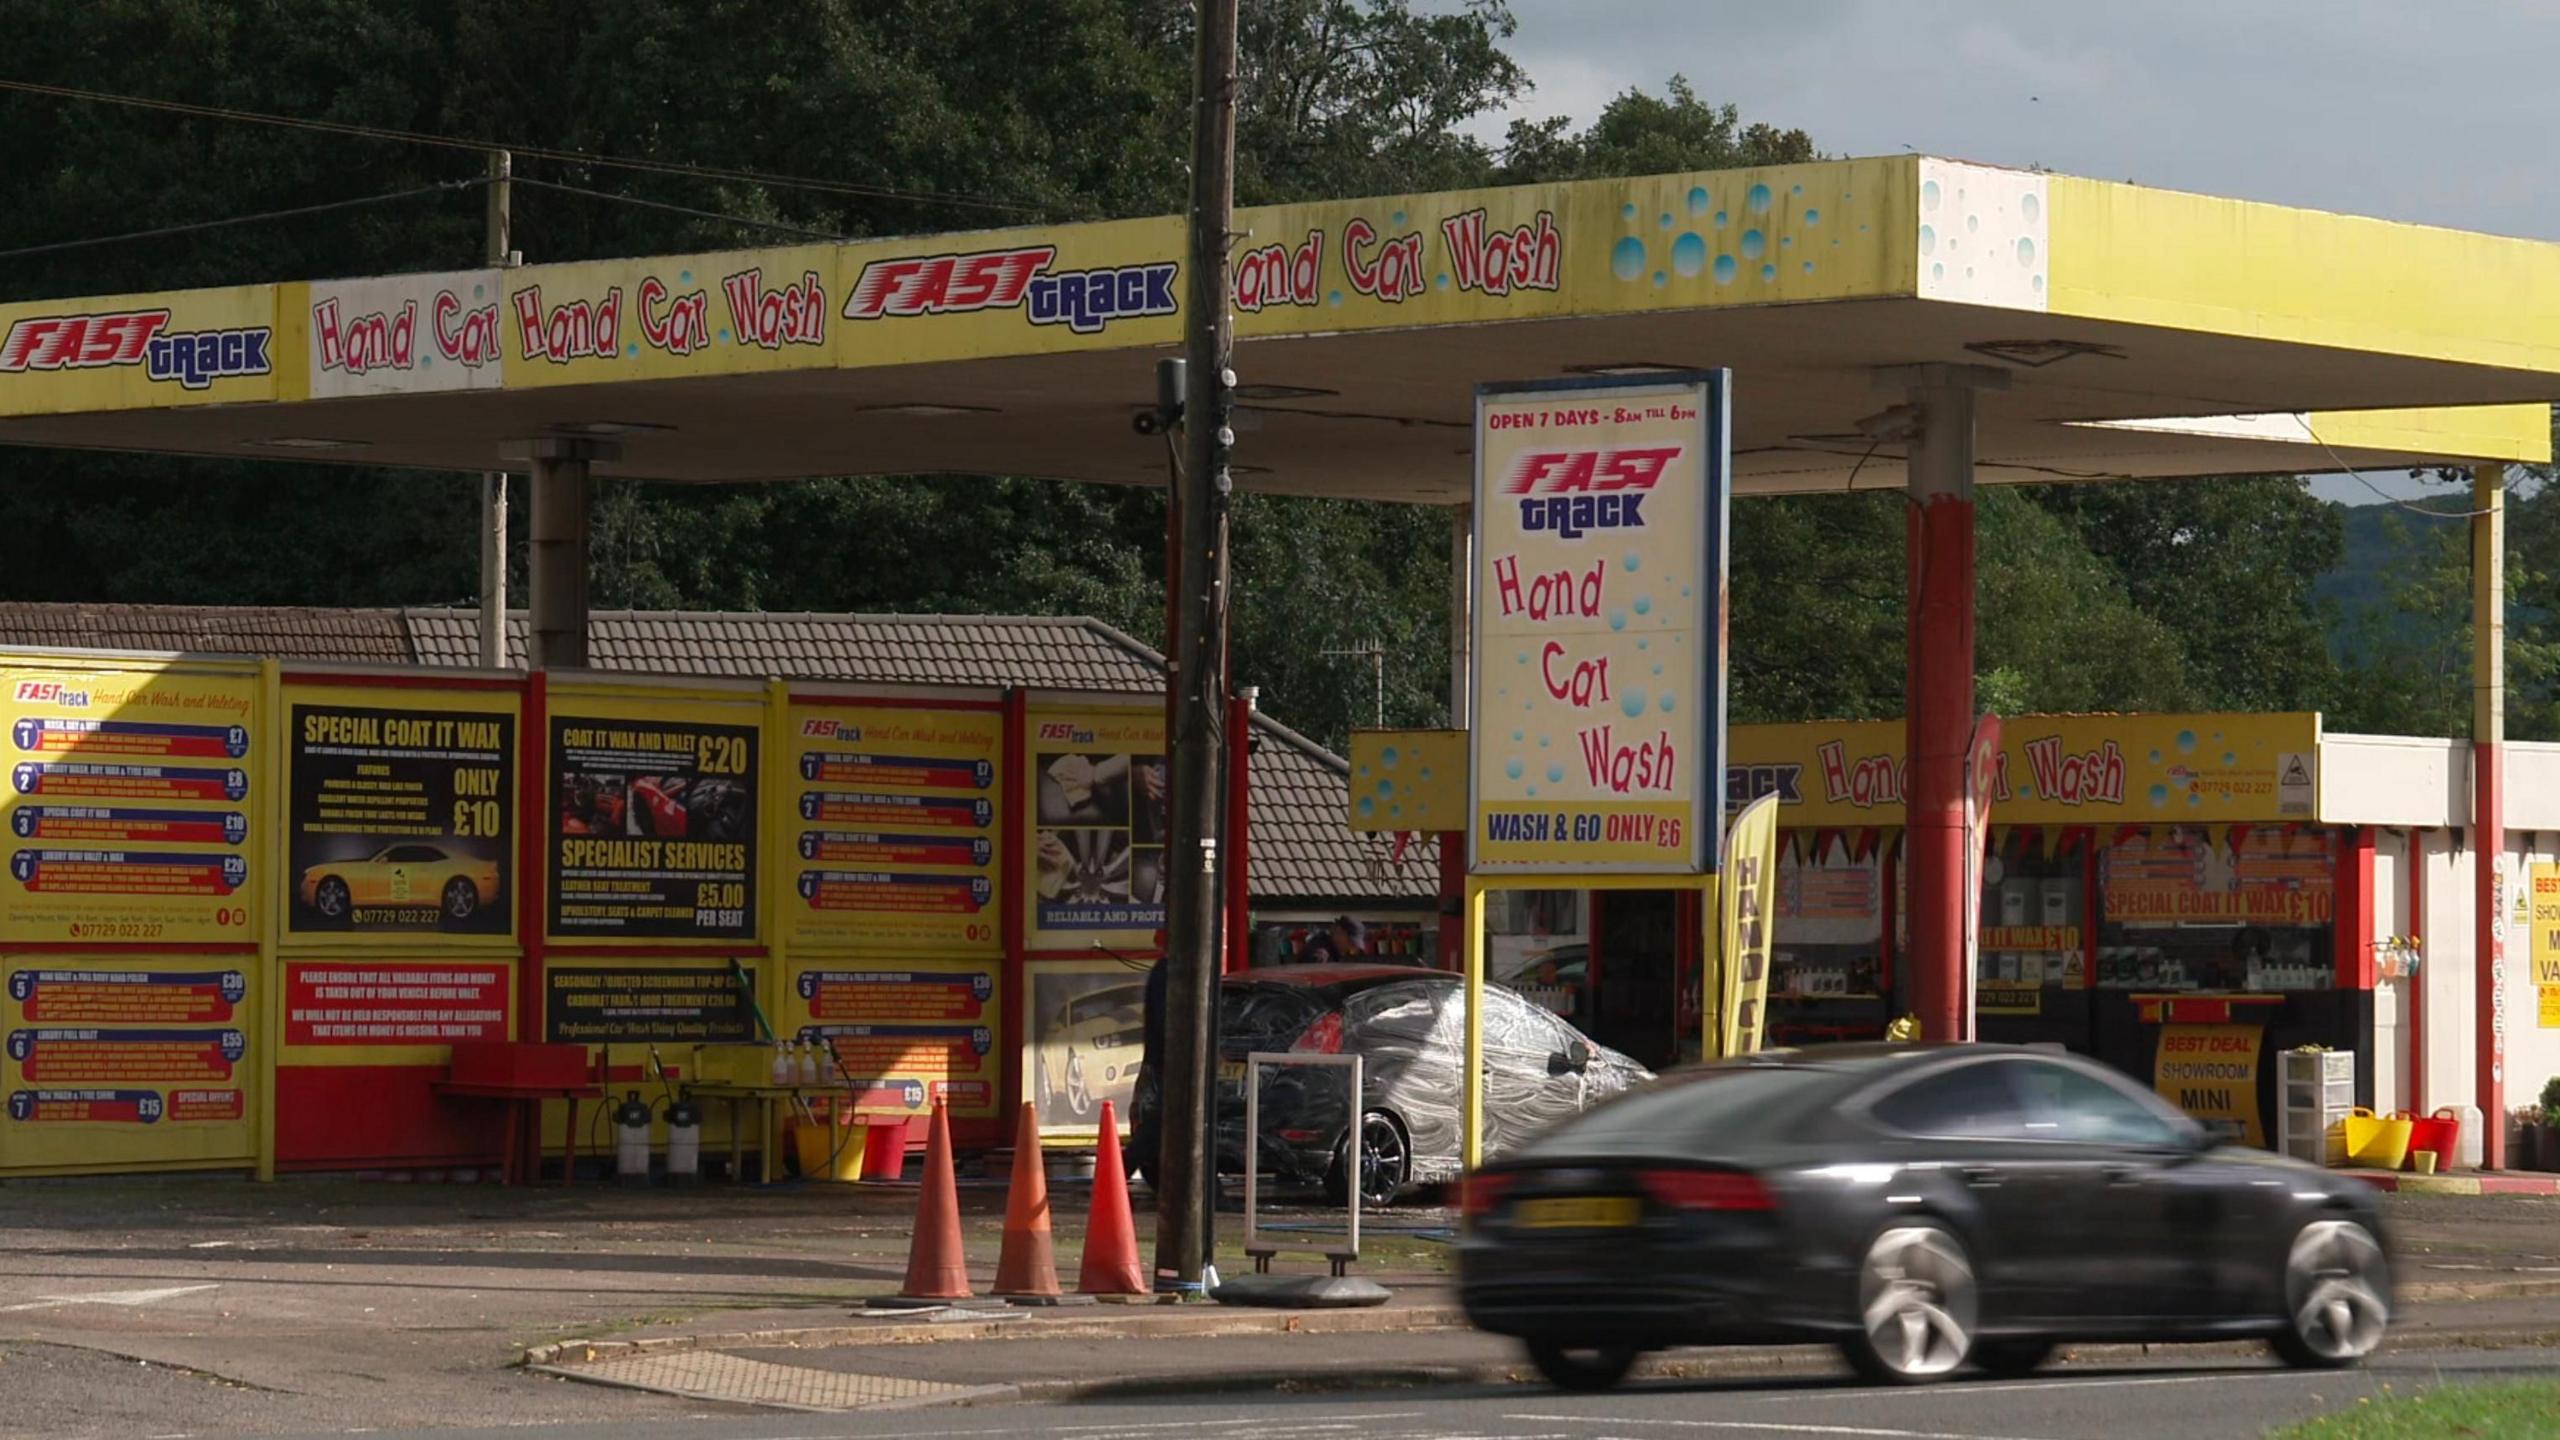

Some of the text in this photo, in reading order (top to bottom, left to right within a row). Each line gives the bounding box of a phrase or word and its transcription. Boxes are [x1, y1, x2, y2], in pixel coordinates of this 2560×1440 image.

[1232, 208, 1561, 312] and Car Wash
[844, 246, 1056, 319] FAST
[513, 267, 825, 364] Hand Car Wash
[2, 310, 169, 371] FAST
[313, 291, 501, 375] Hand Car
[1489, 413, 1534, 429] OPEN
[1540, 412, 1548, 427] 7
[1555, 410, 1599, 426] DAYS
[1646, 408, 1665, 419] TILL
[1501, 448, 1682, 494] FAST
[1493, 555, 1605, 621] Hand
[1542, 640, 1610, 707] Car
[17, 683, 61, 700] FAST
[58, 691, 88, 707] track
[229, 728, 243, 745] £7
[305, 715, 500, 749] SPECIAL COAT IT WAX
[804, 720, 839, 736] FAST
[1039, 724, 1075, 739] FAST
[20, 729, 29, 748] 1
[563, 728, 594, 746] COAT
[596, 730, 607, 747] IT
[609, 731, 637, 748] WAX
[638, 733, 661, 750] AND
[664, 733, 696, 752] VALET
[698, 736, 747, 774] £20
[1578, 725, 1676, 793] Wash
[806, 763, 813, 778] 1
[2024, 736, 2125, 806] Wash
[20, 774, 29, 792] 2
[454, 768, 500, 796] ONLY
[805, 802, 812, 817] 2
[19, 817, 29, 835] 3
[225, 815, 244, 832] £10
[453, 801, 500, 837] £10
[1488, 814, 1681, 847] WASH & GO ONLY £6
[562, 839, 745, 871] SPECIALIST SERVICES
[18, 860, 28, 879] 4
[224, 858, 244, 875] £20
[697, 883, 744, 908] £5.00
[803, 881, 811, 896] 4
[2106, 891, 2331, 921] SPECIAL COAT IT WAX £10
[363, 909, 440, 924] 07729 022 227
[696, 909, 743, 927] PER SEAT
[1046, 910, 1100, 923] RELIABLE
[1103, 910, 1128, 923] AND
[1736, 856, 1763, 983] HAND
[83, 924, 163, 937] 07729 022 227
[16, 981, 25, 998] 5
[222, 974, 243, 990] £30
[803, 981, 811, 996] 5
[15, 1040, 24, 1057] 6
[222, 1033, 242, 1048] £55
[2165, 1036, 2251, 1053] BEST DEAL
[2162, 1063, 2249, 1080] SHOWROOM
[904, 1086, 922, 1102] £15
[2180, 1089, 2231, 1111] MINI
[16, 1101, 24, 1118] 7
[139, 1099, 160, 1117] £15
